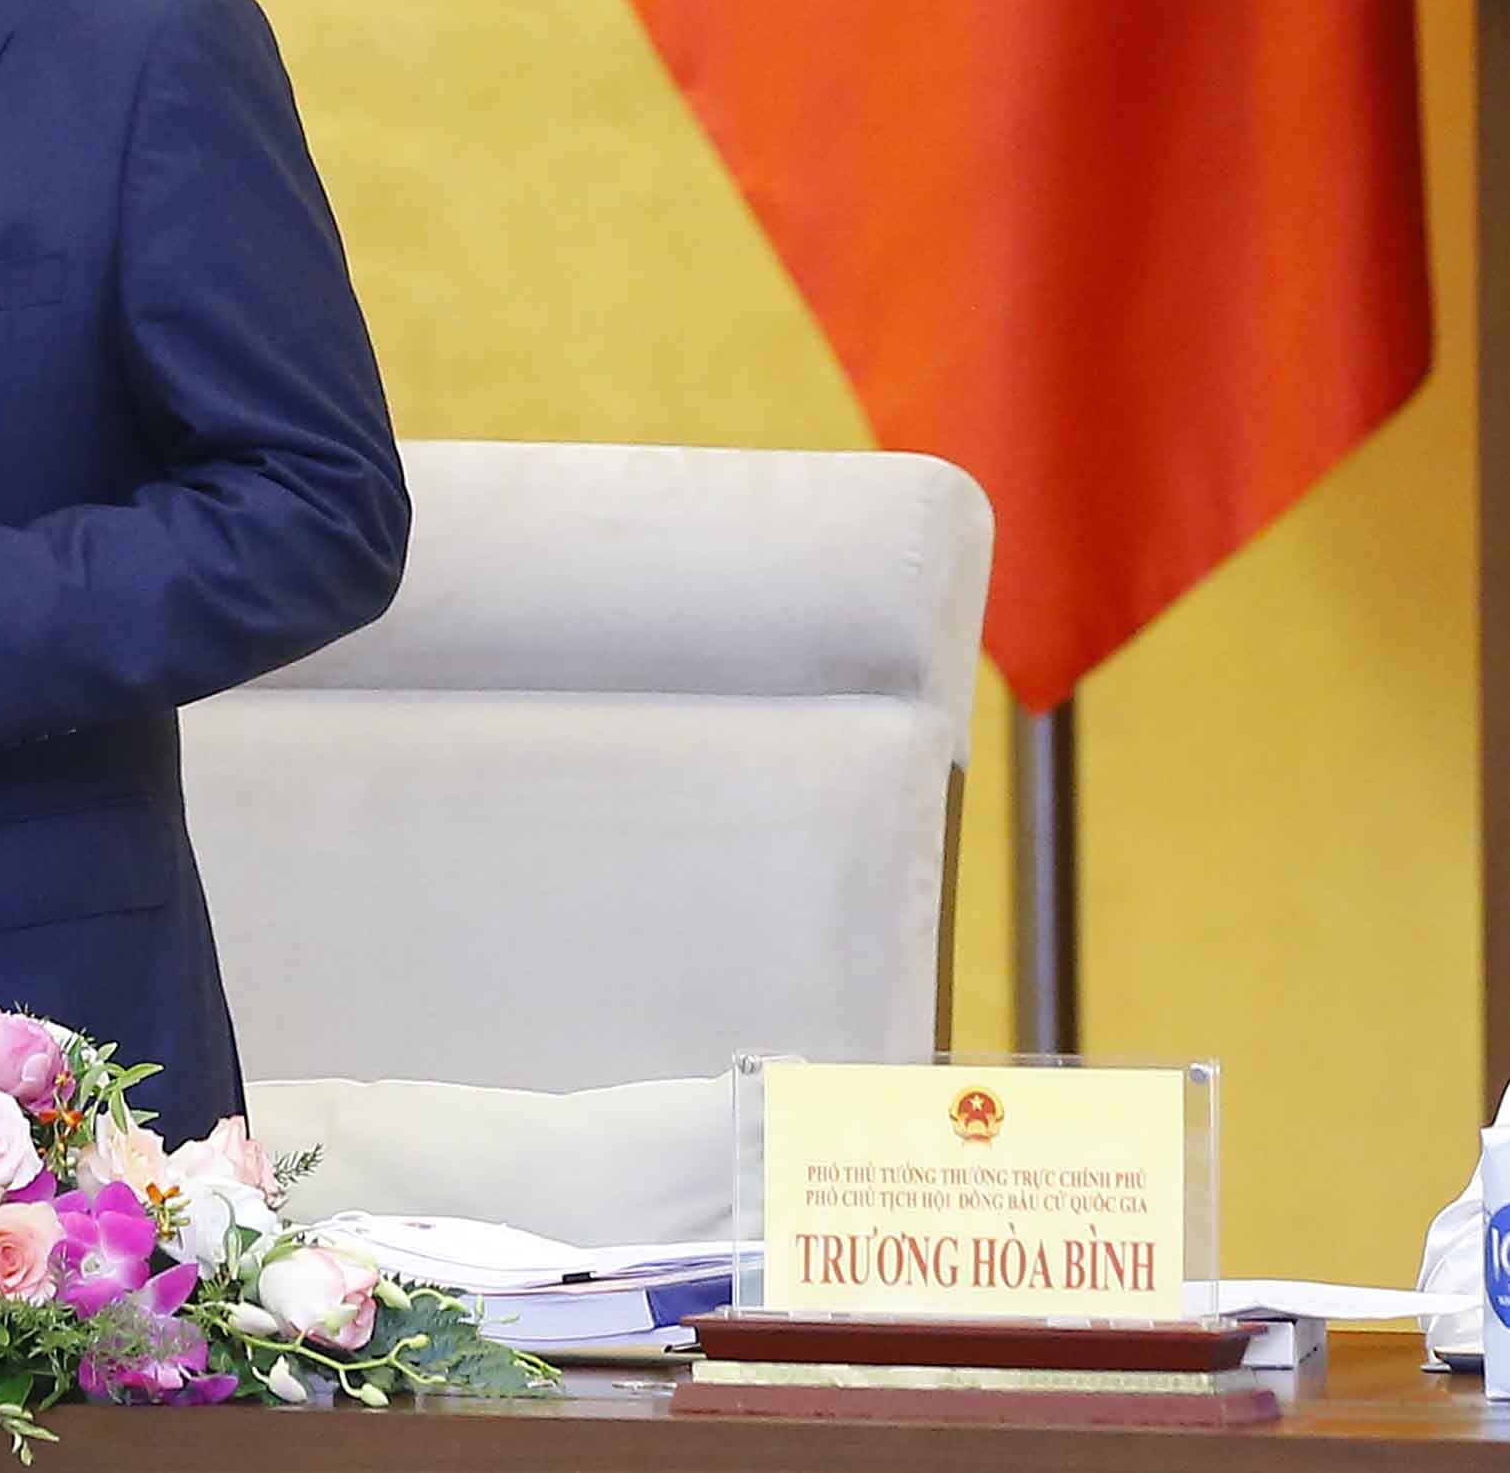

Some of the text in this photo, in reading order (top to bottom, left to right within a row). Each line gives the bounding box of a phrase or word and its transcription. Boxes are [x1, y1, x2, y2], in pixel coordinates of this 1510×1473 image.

[807, 1162, 840, 1183] PHÓ
[1012, 1169, 1056, 1190] TRỰC
[880, 1191, 918, 1213] TỊCH
[922, 1191, 951, 1213] HỘI
[1070, 1192, 1116, 1215] QUỐC
[1119, 1196, 1148, 1214] GIA
[795, 1222, 1157, 1293] TRƯƠNG HÒA BÌNH
